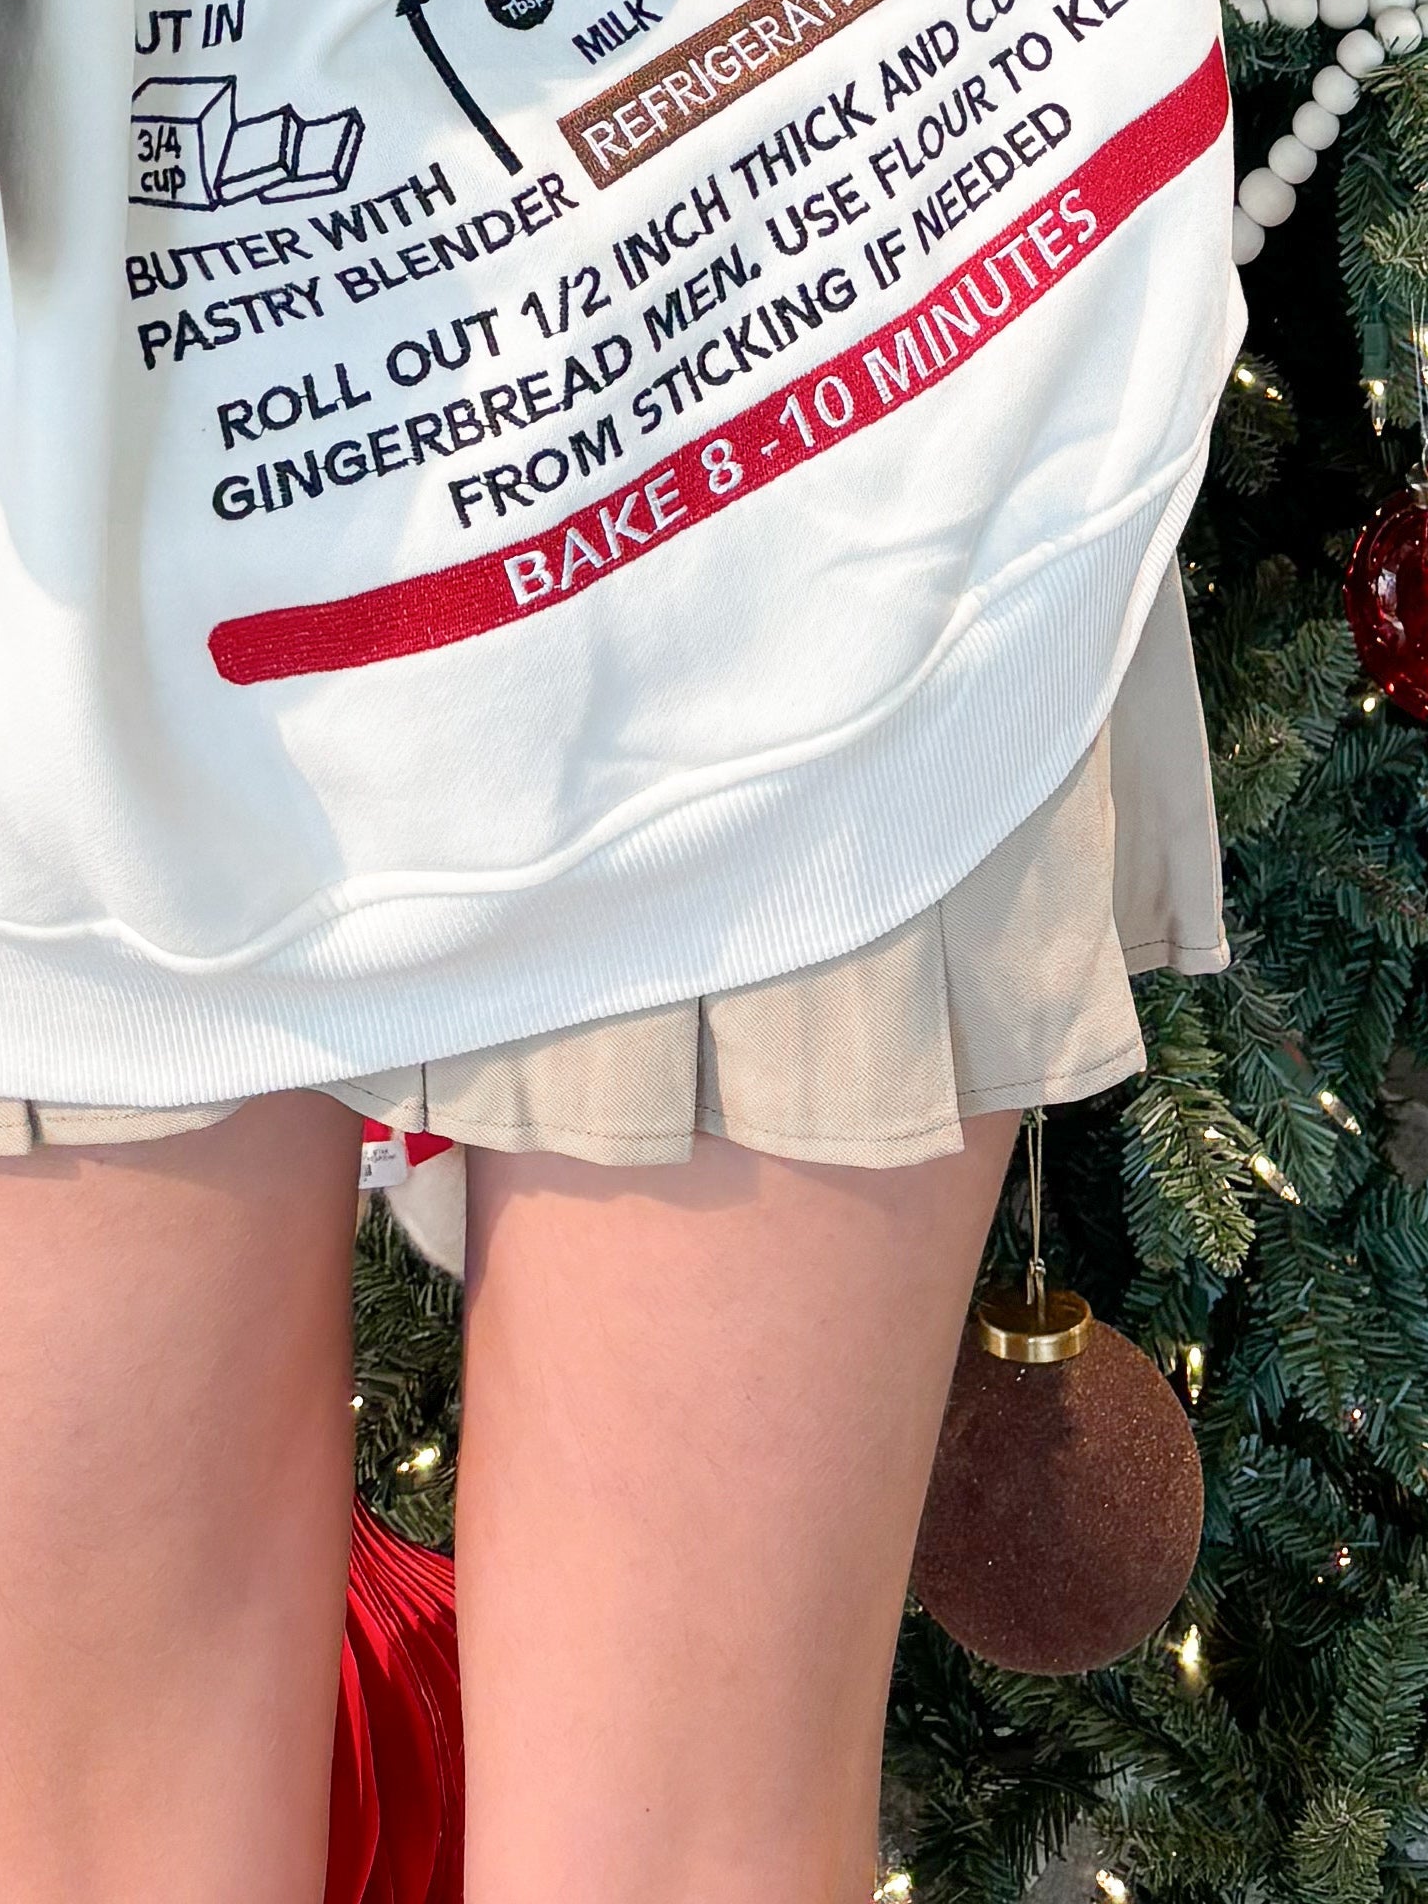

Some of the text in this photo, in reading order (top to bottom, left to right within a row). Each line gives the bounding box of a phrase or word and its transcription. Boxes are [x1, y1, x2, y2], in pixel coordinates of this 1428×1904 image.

[135, 8, 192, 55] UT
[125, 162, 457, 301] BUTTER WITH
[137, 124, 182, 163] 3/4
[140, 164, 187, 199] cup
[216, 362, 372, 451] ROLL
[386, 307, 503, 388] OUT
[521, 265, 613, 340] 1/2
[612, 175, 731, 290] INCH
[731, 79, 875, 195] THICK
[878, 19, 960, 113] AND
[137, 172, 580, 371] PASTRY BLENDER
[211, 333, 633, 521] GINGERBREAD
[642, 242, 764, 353] MEN.
[765, 175, 872, 259] USE
[868, 73, 1000, 200] FLOUR
[989, 30, 1053, 94] TO
[448, 100, 1072, 529] FROM STICKING IF NEEDED
[502, 468, 689, 606] BAKE
[699, 437, 745, 495] 8
[861, 186, 1098, 405] MINUTES
